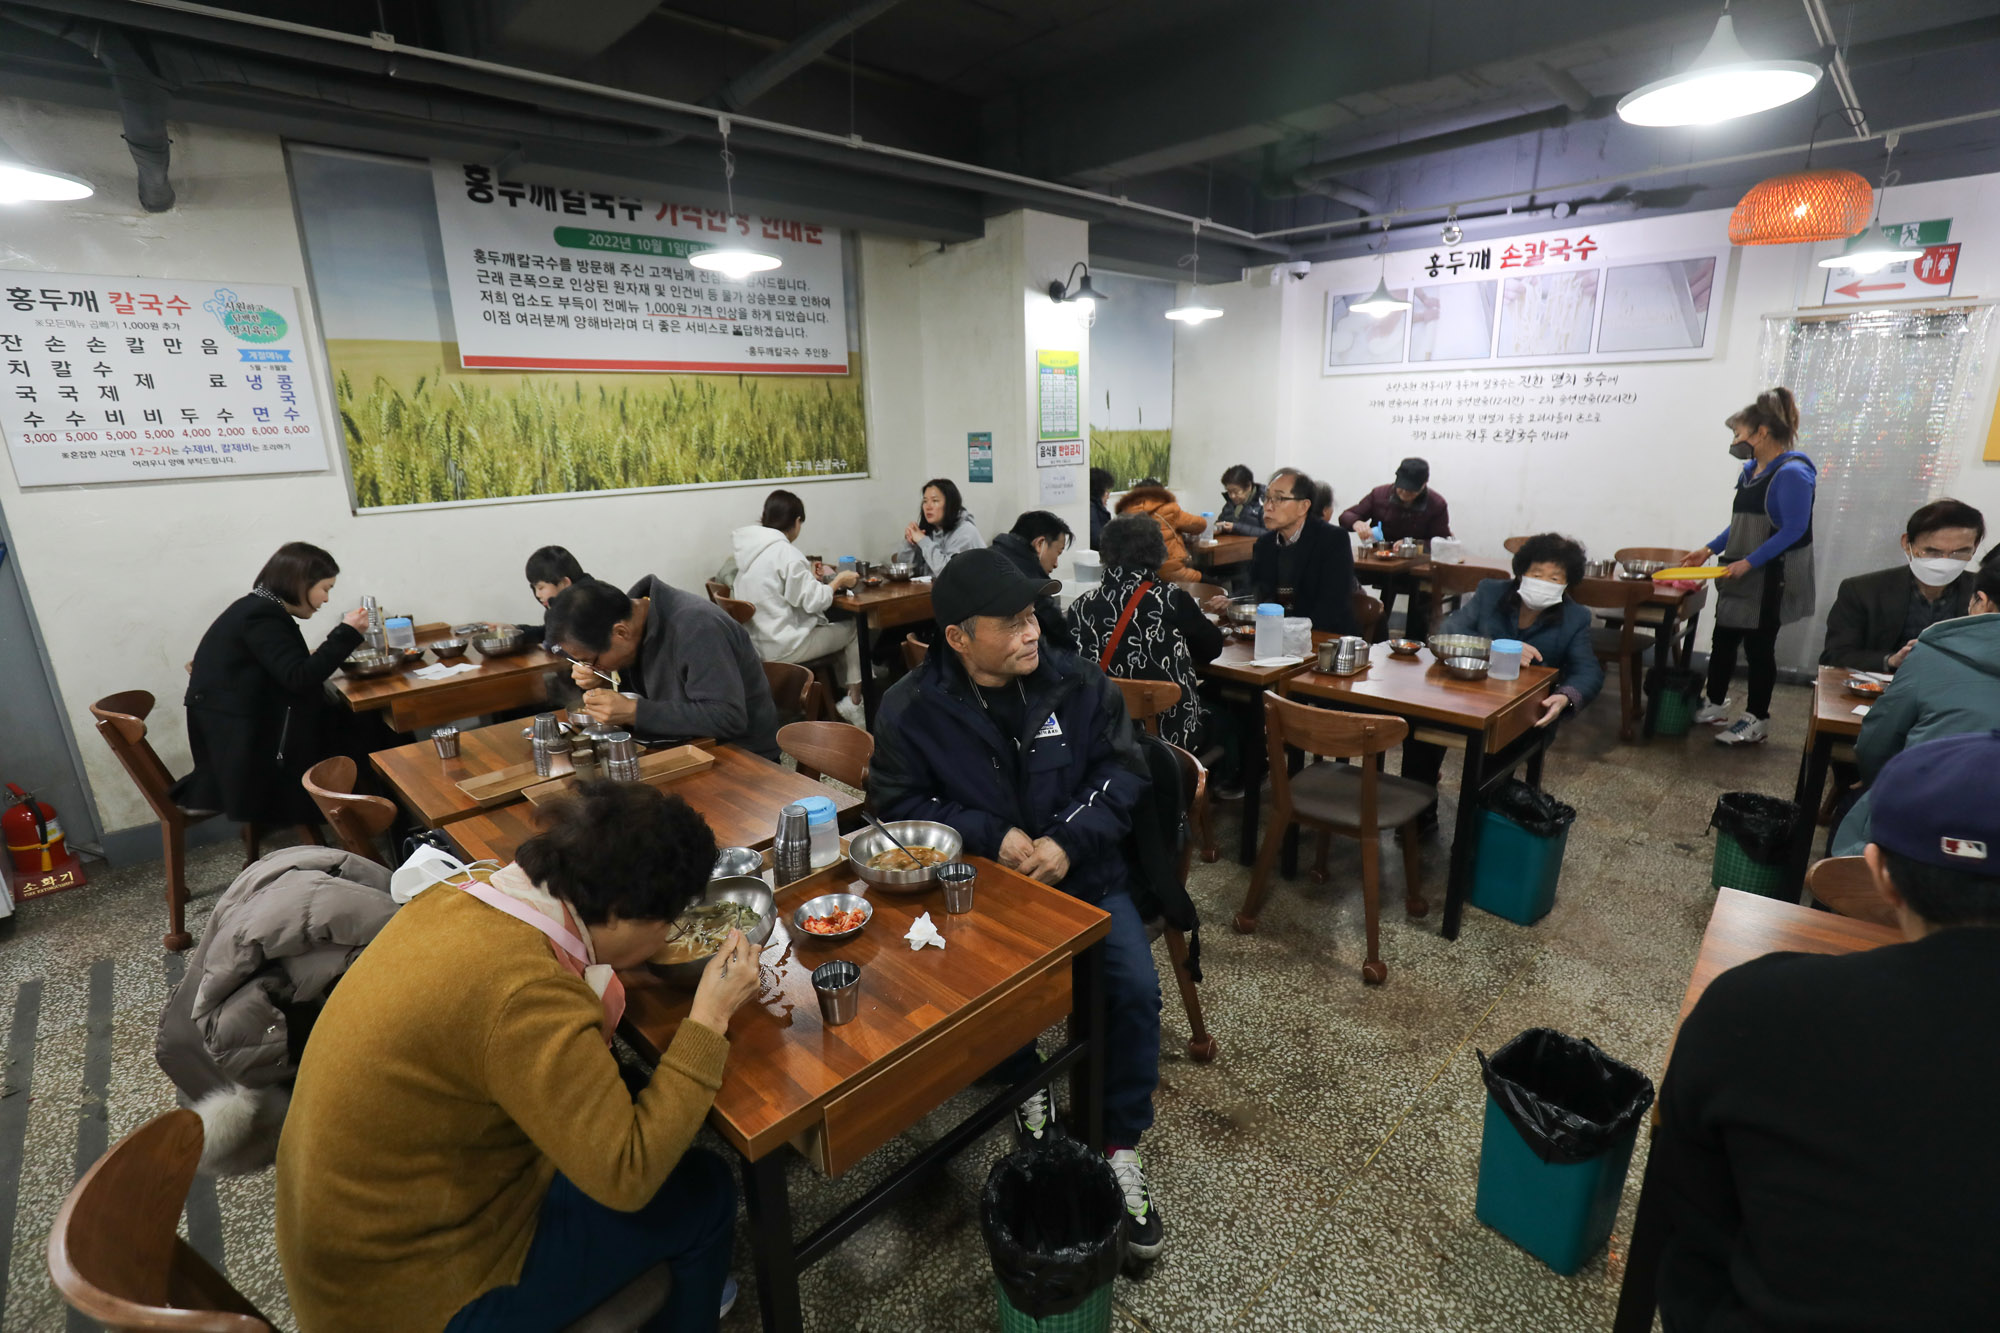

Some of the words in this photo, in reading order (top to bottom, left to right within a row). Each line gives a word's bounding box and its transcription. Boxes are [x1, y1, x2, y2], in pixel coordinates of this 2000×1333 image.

[588, 233, 632, 250] 2022년
[637, 238, 663, 252] 10월
[473, 248, 572, 272] 홍두깨칼국수를
[577, 259, 616, 276] 방문해
[620, 263, 645, 278] 주신
[649, 266, 695, 283] 고객님께
[1425, 247, 1491, 278] 홍두깨
[1499, 235, 1598, 270] 손칼국수
[477, 269, 505, 286] 근래
[509, 272, 565, 290] 큰폭으로
[569, 278, 609, 294] 인상된
[613, 280, 651, 297] 원자재
[655, 284, 667, 297] 및
[670, 285, 704, 301] 인건비
[707, 289, 719, 302] 등
[722, 290, 743, 304] 물가
[747, 293, 797, 307] 상승분으로
[800, 296, 831, 309] 인하여
[6, 286, 100, 313] 홍두깨
[107, 291, 192, 317] 칼국수
[480, 289, 508, 306] 저희
[512, 293, 555, 308] 업소도
[558, 296, 598, 312] 부득이
[602, 299, 640, 314] 전메뉴
[645, 302, 688, 316] 1,000원
[691, 305, 713, 318] 가격
[716, 306, 748, 320] 인상을
[752, 309, 772, 322] 하게
[775, 311, 830, 324] 되었습니다.
[483, 310, 512, 326] 이점
[516, 313, 570, 329] 여러분께
[574, 315, 639, 332] 양해바라며
[643, 319, 654, 332] 더
[658, 319, 682, 333] 좋은
[685, 321, 729, 335] 서비스로
[1520, 374, 1545, 389] 진한
[1551, 372, 1577, 389] 멸치
[277, 374, 300, 421] 콩국수
[23, 433, 57, 444] 3,000
[65, 431, 98, 442] 5,000
[106, 430, 137, 441] 5,000
[144, 429, 175, 440] 5,000
[182, 428, 211, 438] 4,000
[217, 427, 246, 437] 2,000
[252, 426, 279, 436] 6,000
[284, 425, 310, 435] 6,000
[1466, 429, 1488, 443] 전통
[1493, 427, 1538, 444] 손칼국수
[100, 449, 126, 458] 시간대
[132, 459, 166, 468] 어려우니
[168, 459, 185, 467] 양해
[24, 871, 74, 892] 소화기
